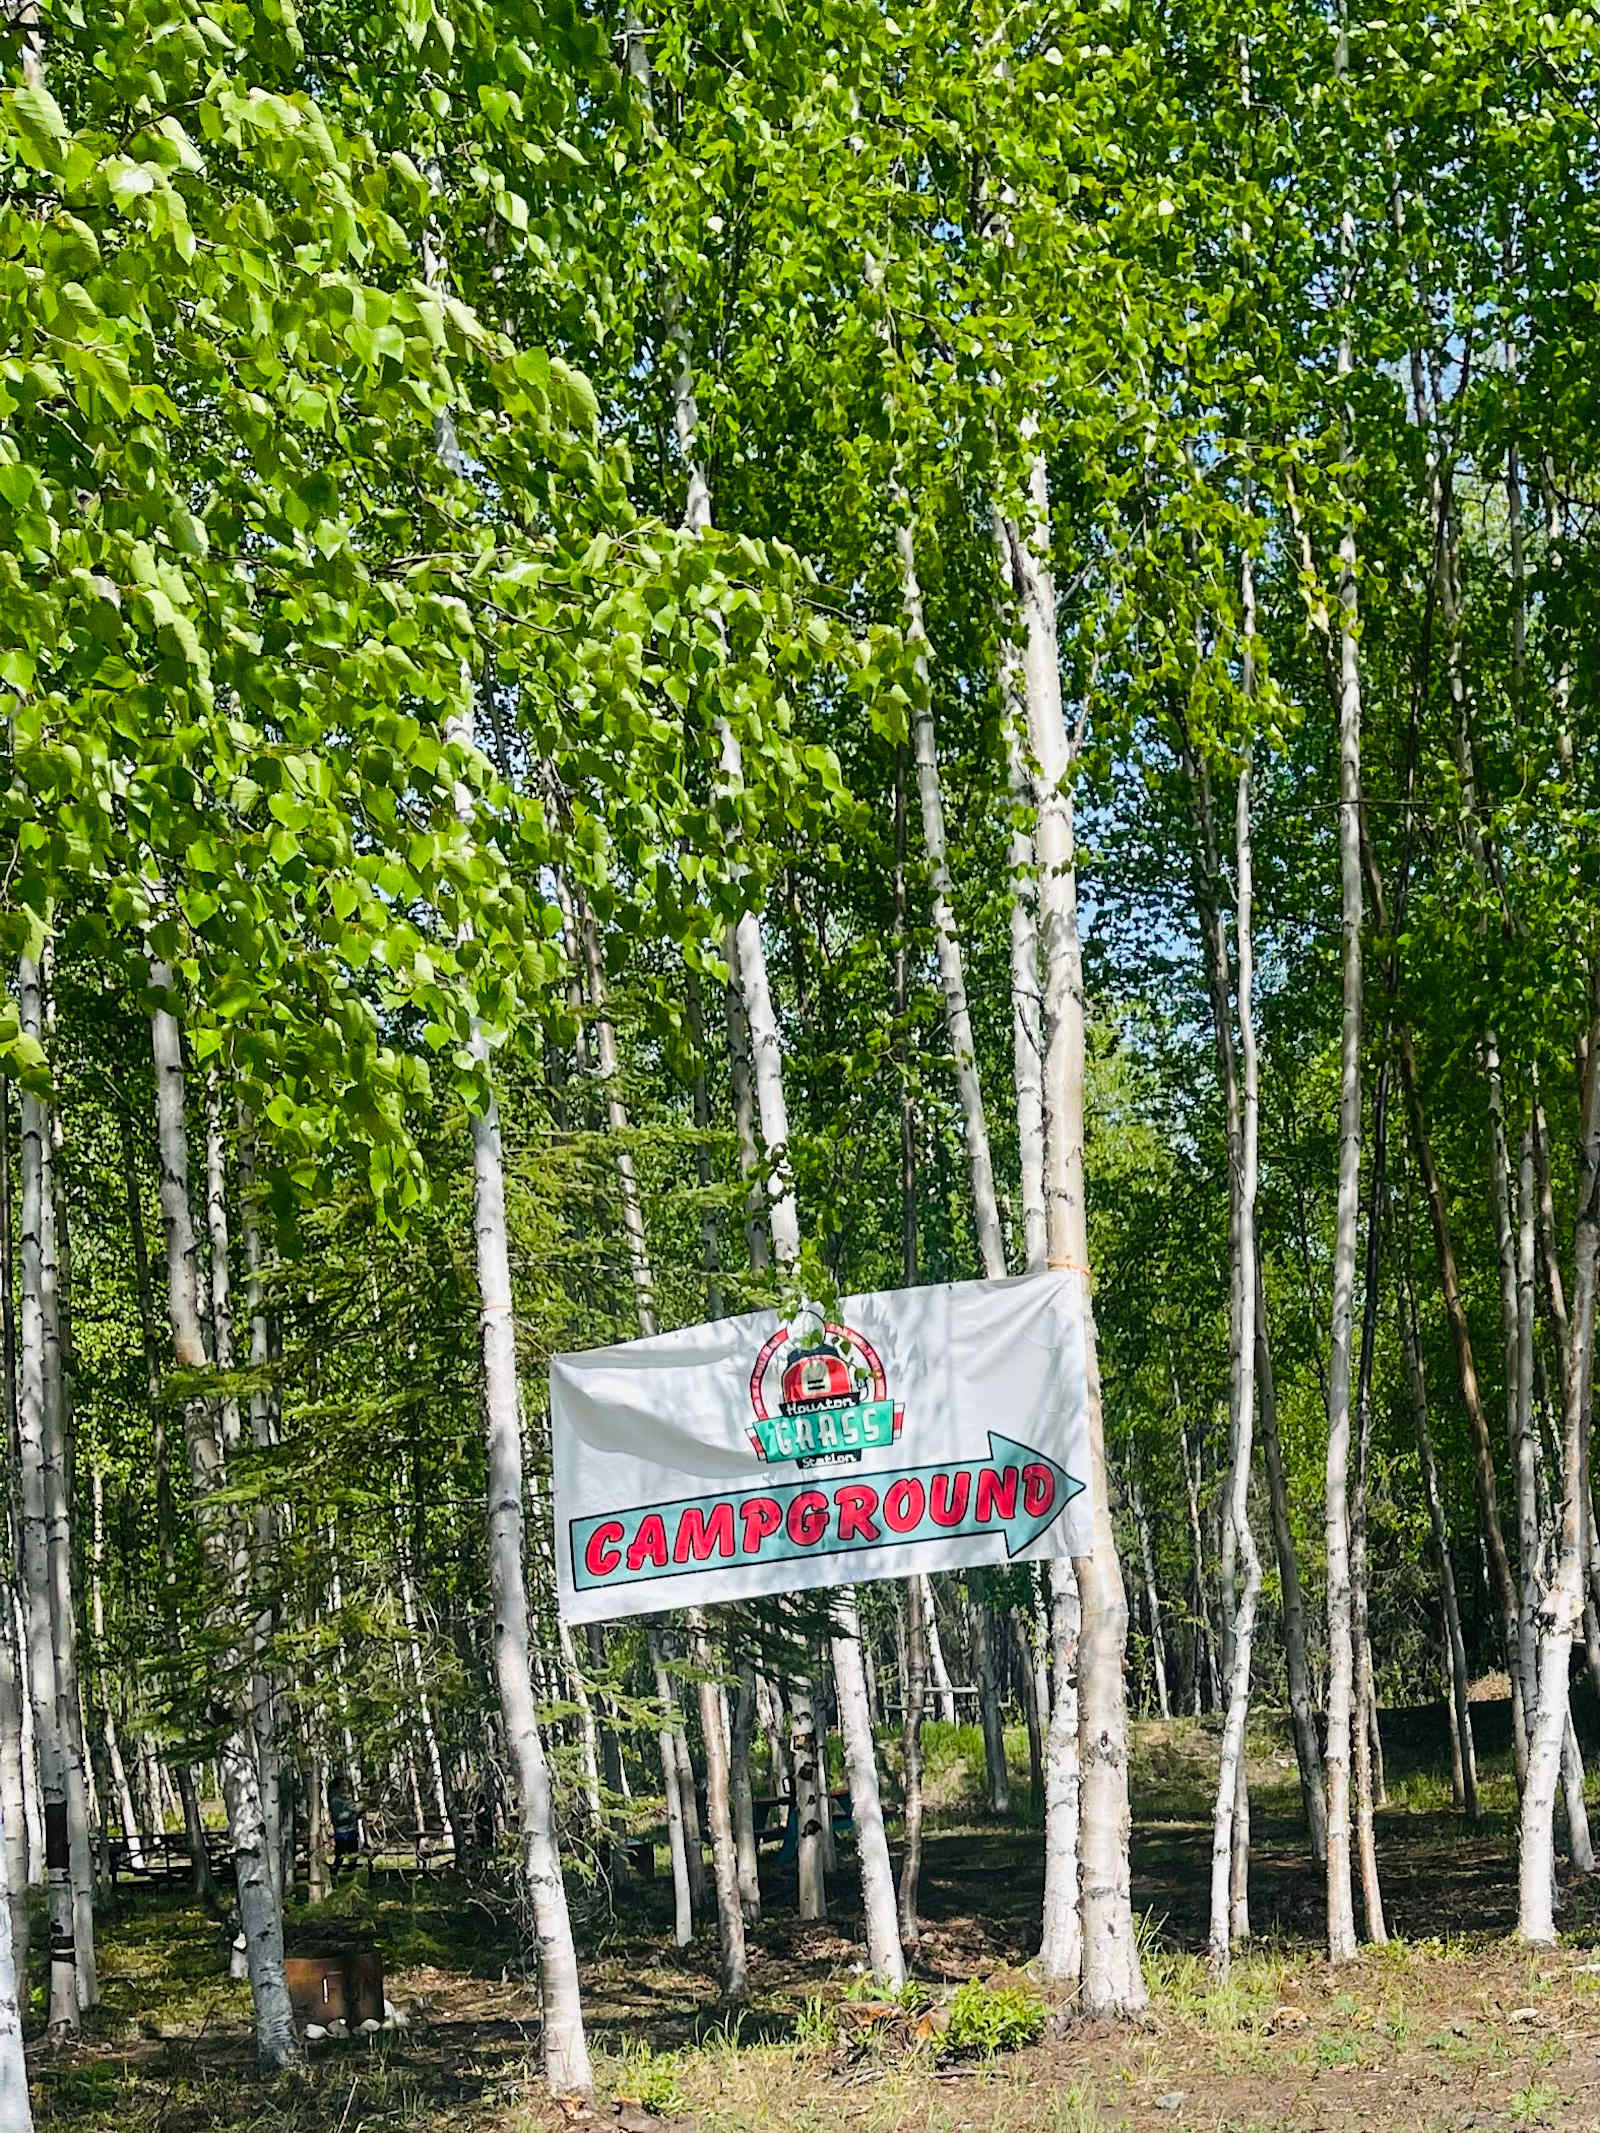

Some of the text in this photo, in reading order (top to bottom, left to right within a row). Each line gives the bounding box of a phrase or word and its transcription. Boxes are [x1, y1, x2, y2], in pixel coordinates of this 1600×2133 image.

[786, 1397, 857, 1416] Houston
[774, 1407, 880, 1456] GRASS
[801, 1452, 857, 1469] Station
[585, 1463, 1057, 1576] CAMPGROUND
